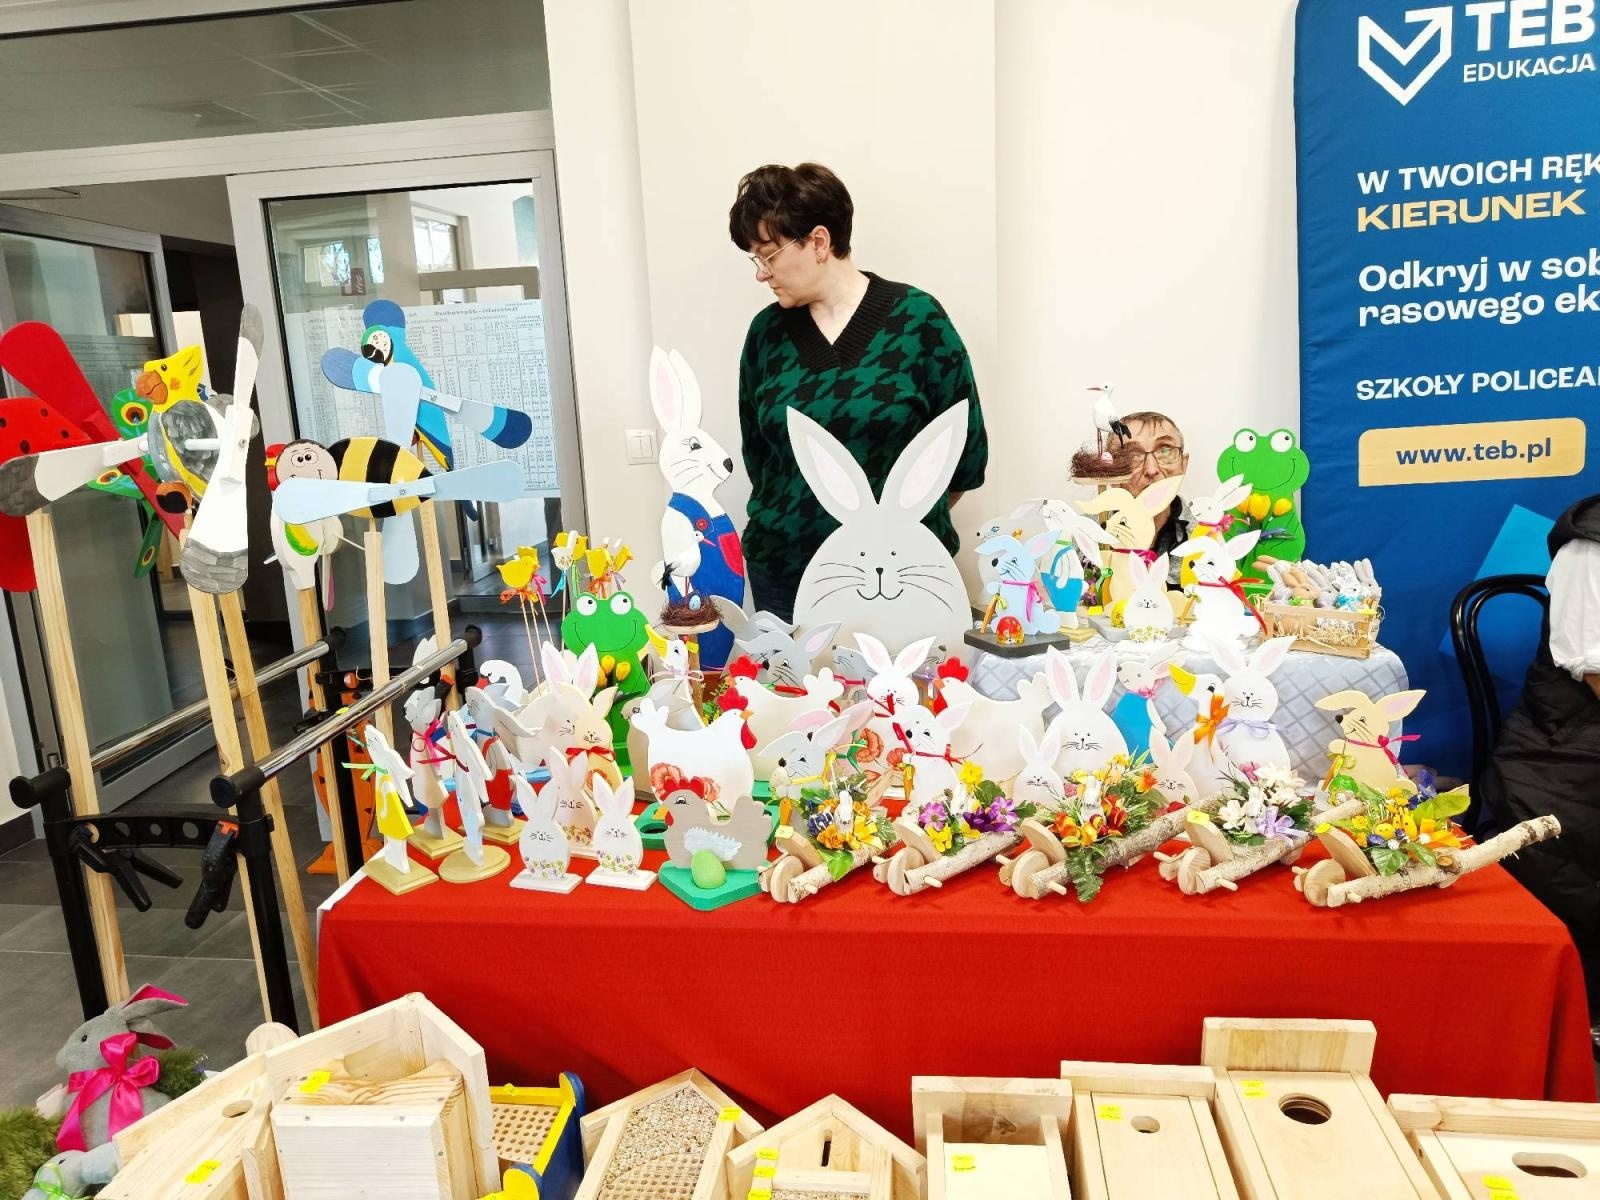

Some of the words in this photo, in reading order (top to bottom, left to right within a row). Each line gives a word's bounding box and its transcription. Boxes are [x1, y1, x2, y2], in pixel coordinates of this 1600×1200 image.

[1465, 0, 1595, 51] TEB
[1463, 53, 1596, 83] EDUKACJA
[1357, 170, 1389, 195] W
[1398, 158, 1532, 191] TWOICH
[1357, 189, 1586, 232] KIERUNEK
[1358, 256, 1488, 292] Odkryj
[1498, 260, 1532, 283] w
[1359, 292, 1545, 327] rasowego
[1356, 373, 1464, 401] SZKOŁY
[1472, 366, 1600, 393] POLICEA
[1396, 437, 1552, 465] www.teb.pl
